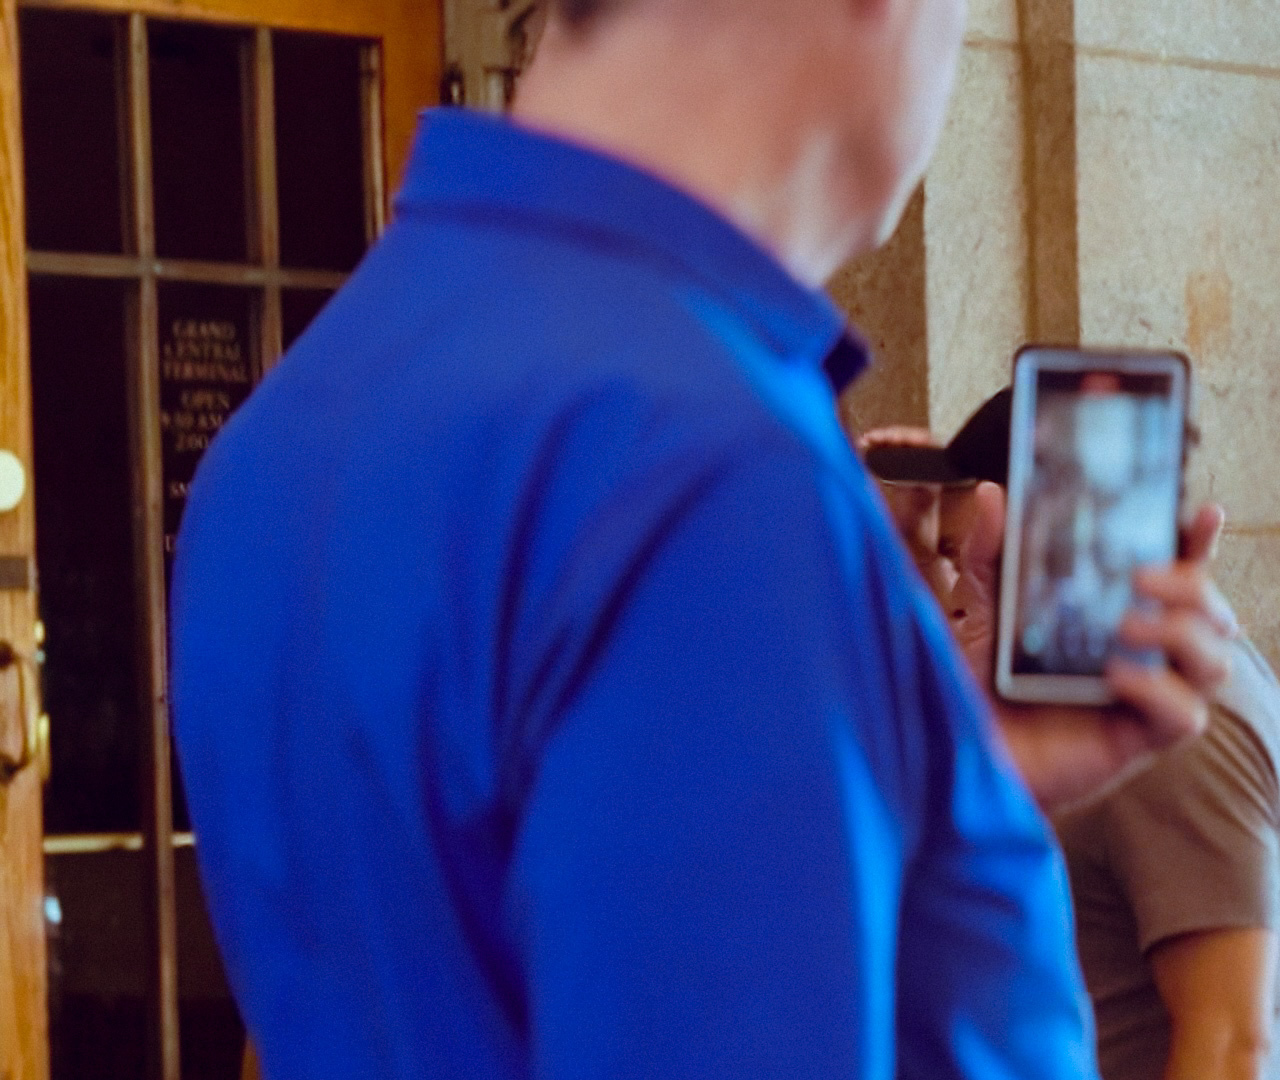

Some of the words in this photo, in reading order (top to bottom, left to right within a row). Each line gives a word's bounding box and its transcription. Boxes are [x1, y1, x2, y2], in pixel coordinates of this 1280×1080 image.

[172, 320, 236, 339] GRAND
[163, 341, 241, 360] CENTRAL
[163, 361, 248, 382] TERMINAL
[181, 391, 230, 410] OPEN
